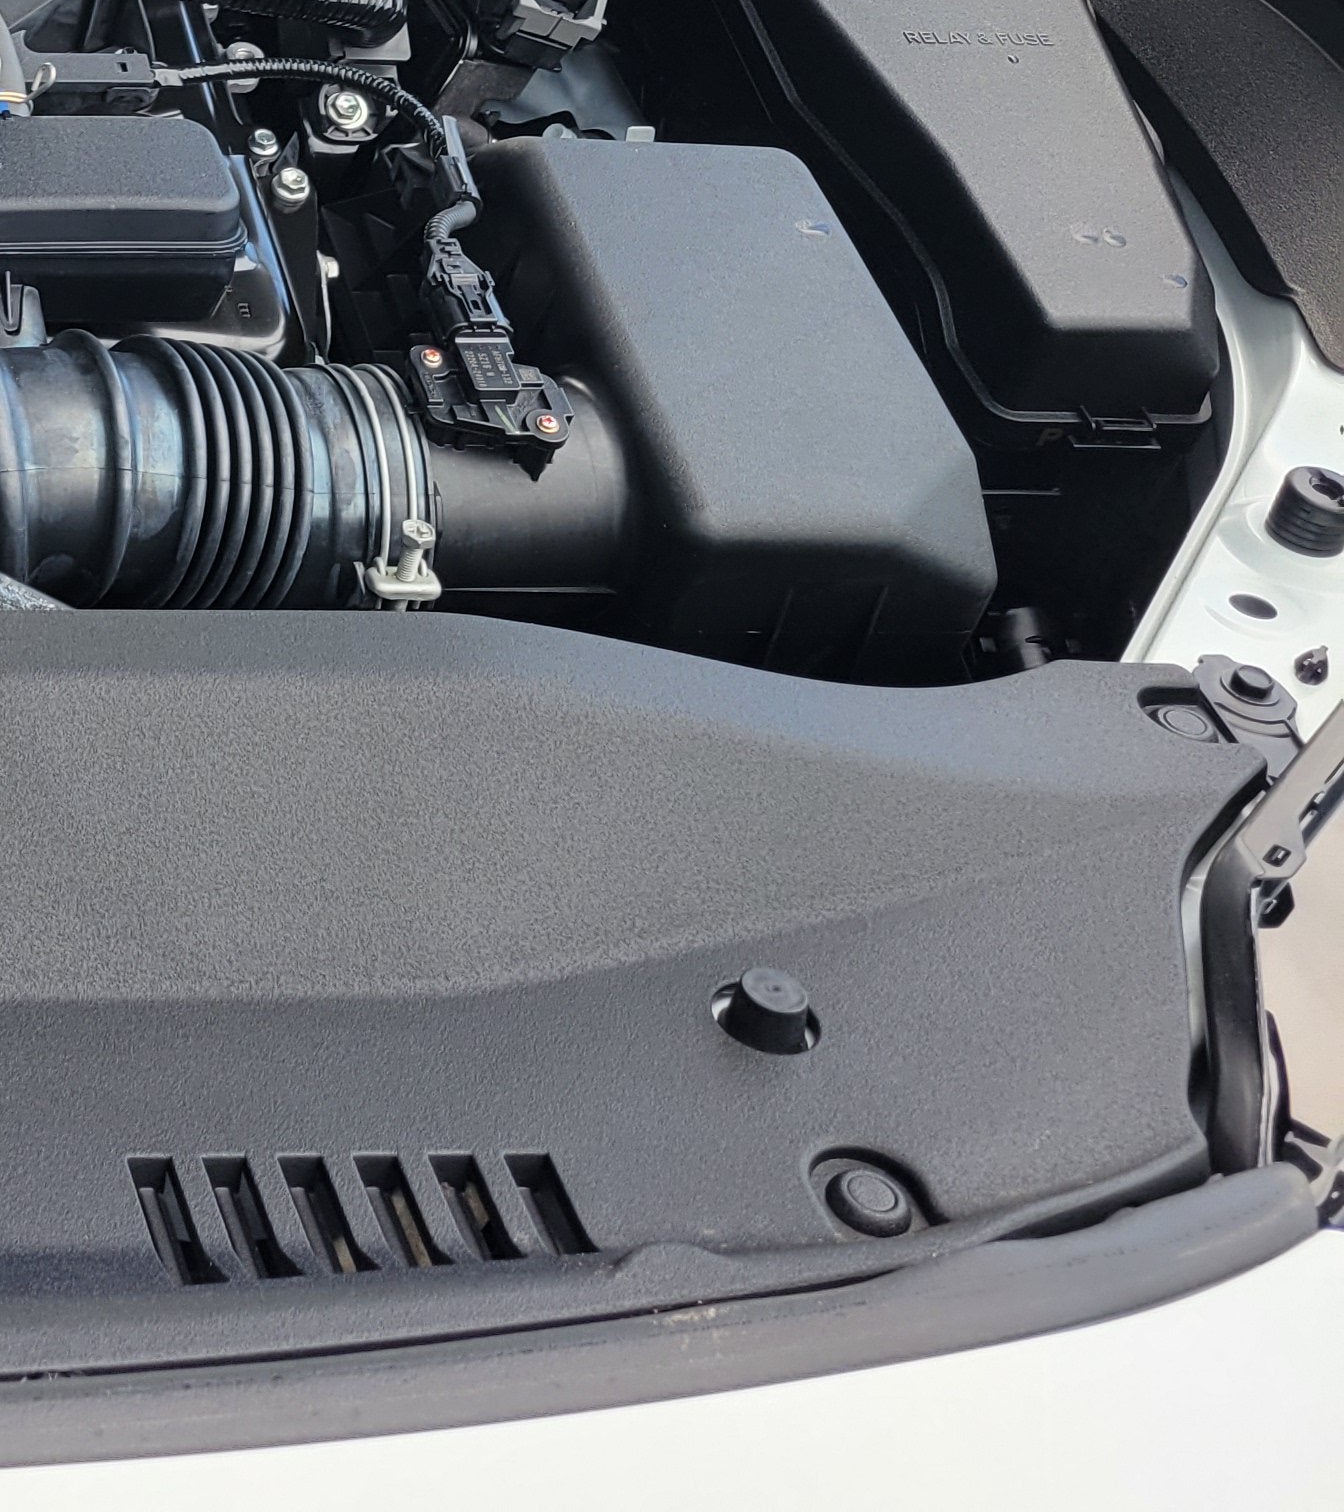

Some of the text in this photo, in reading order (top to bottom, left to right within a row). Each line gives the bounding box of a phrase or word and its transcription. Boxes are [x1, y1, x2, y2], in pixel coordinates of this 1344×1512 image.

[902, 30, 1056, 47] RELAY & FUSE
